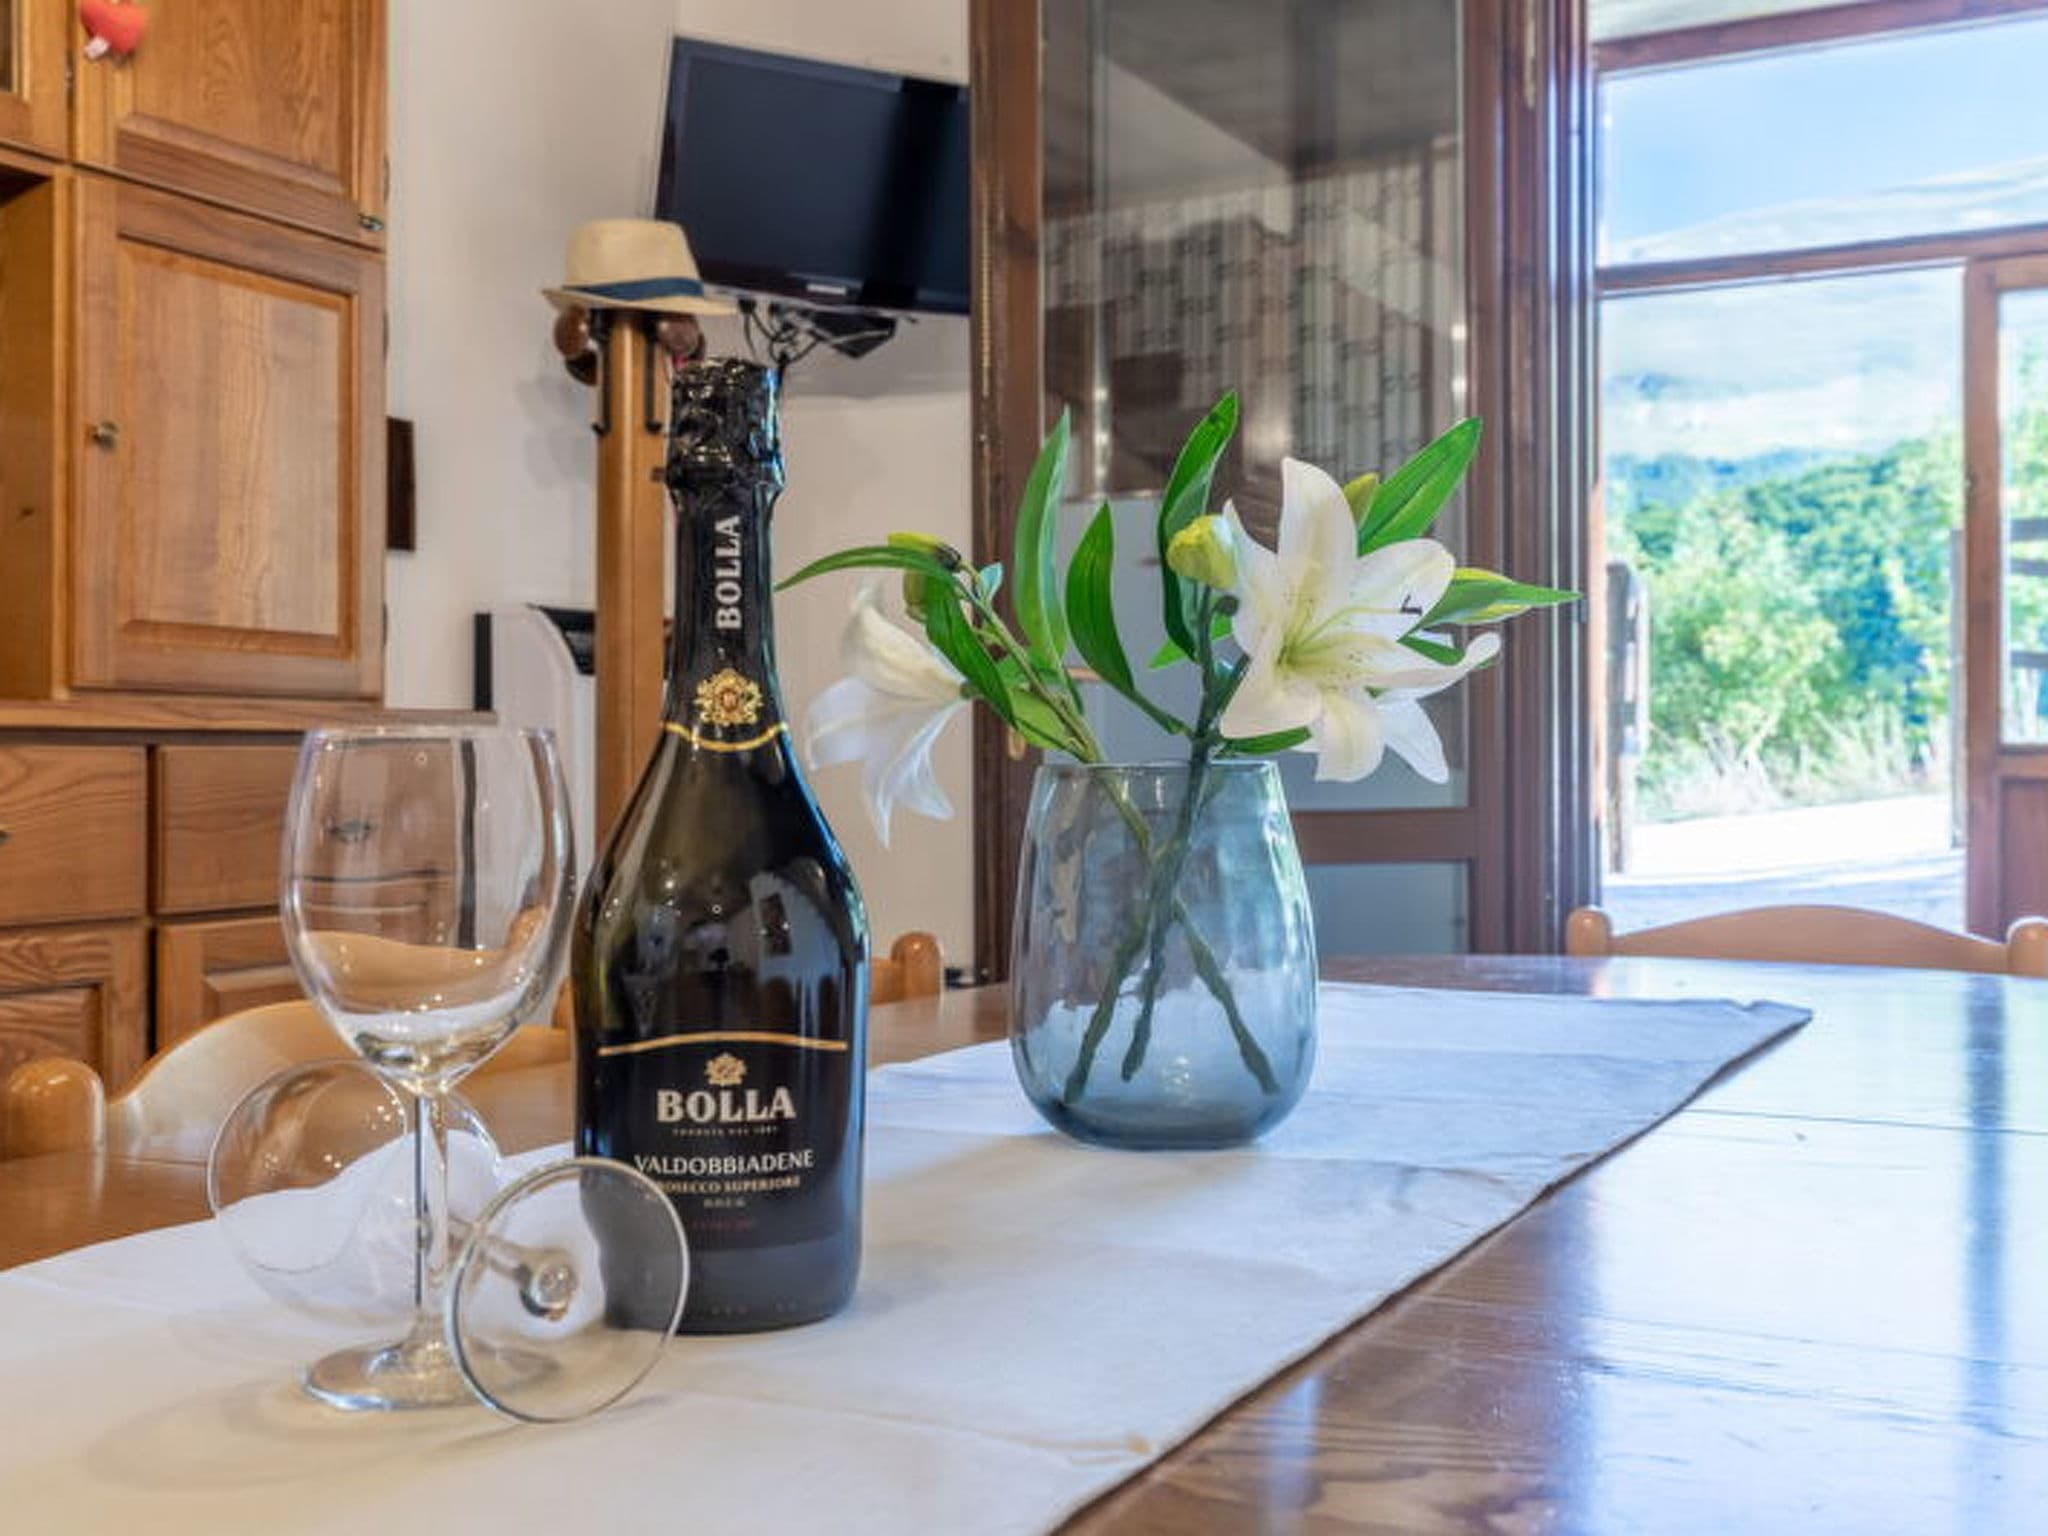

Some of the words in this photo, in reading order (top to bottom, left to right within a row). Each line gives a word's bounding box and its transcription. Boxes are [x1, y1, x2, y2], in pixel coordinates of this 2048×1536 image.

[715, 515, 742, 629] BOLLA
[656, 1086, 797, 1123] BOLLA
[634, 1149, 815, 1176] VALDOBBIADENE
[655, 1179, 721, 1194] OSECCO
